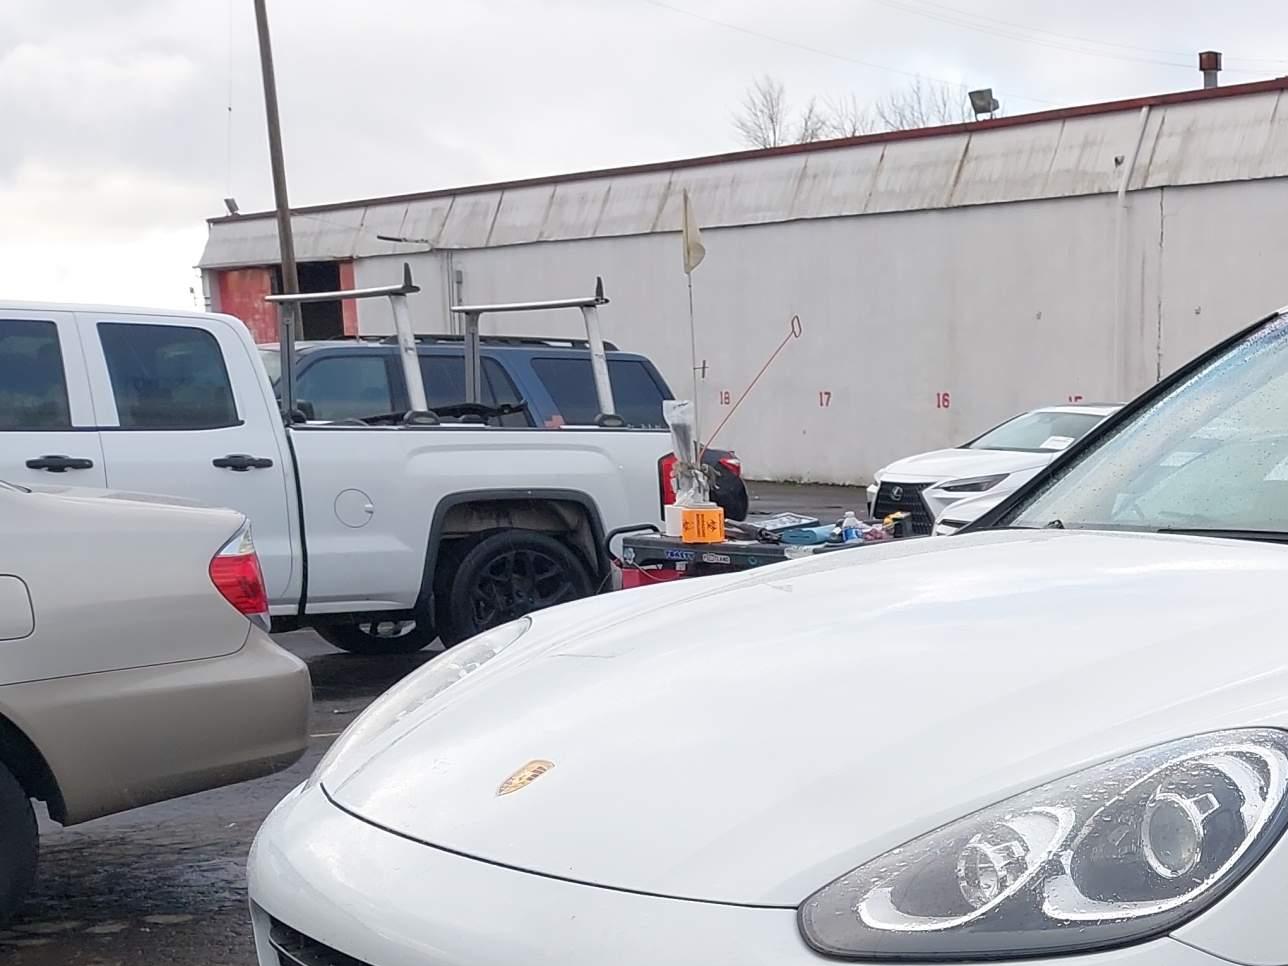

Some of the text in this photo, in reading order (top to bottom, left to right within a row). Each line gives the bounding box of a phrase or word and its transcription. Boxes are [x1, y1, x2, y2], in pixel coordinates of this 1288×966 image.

[720, 391, 731, 405] 18
[819, 391, 832, 407] 17
[936, 392, 950, 409] 16
